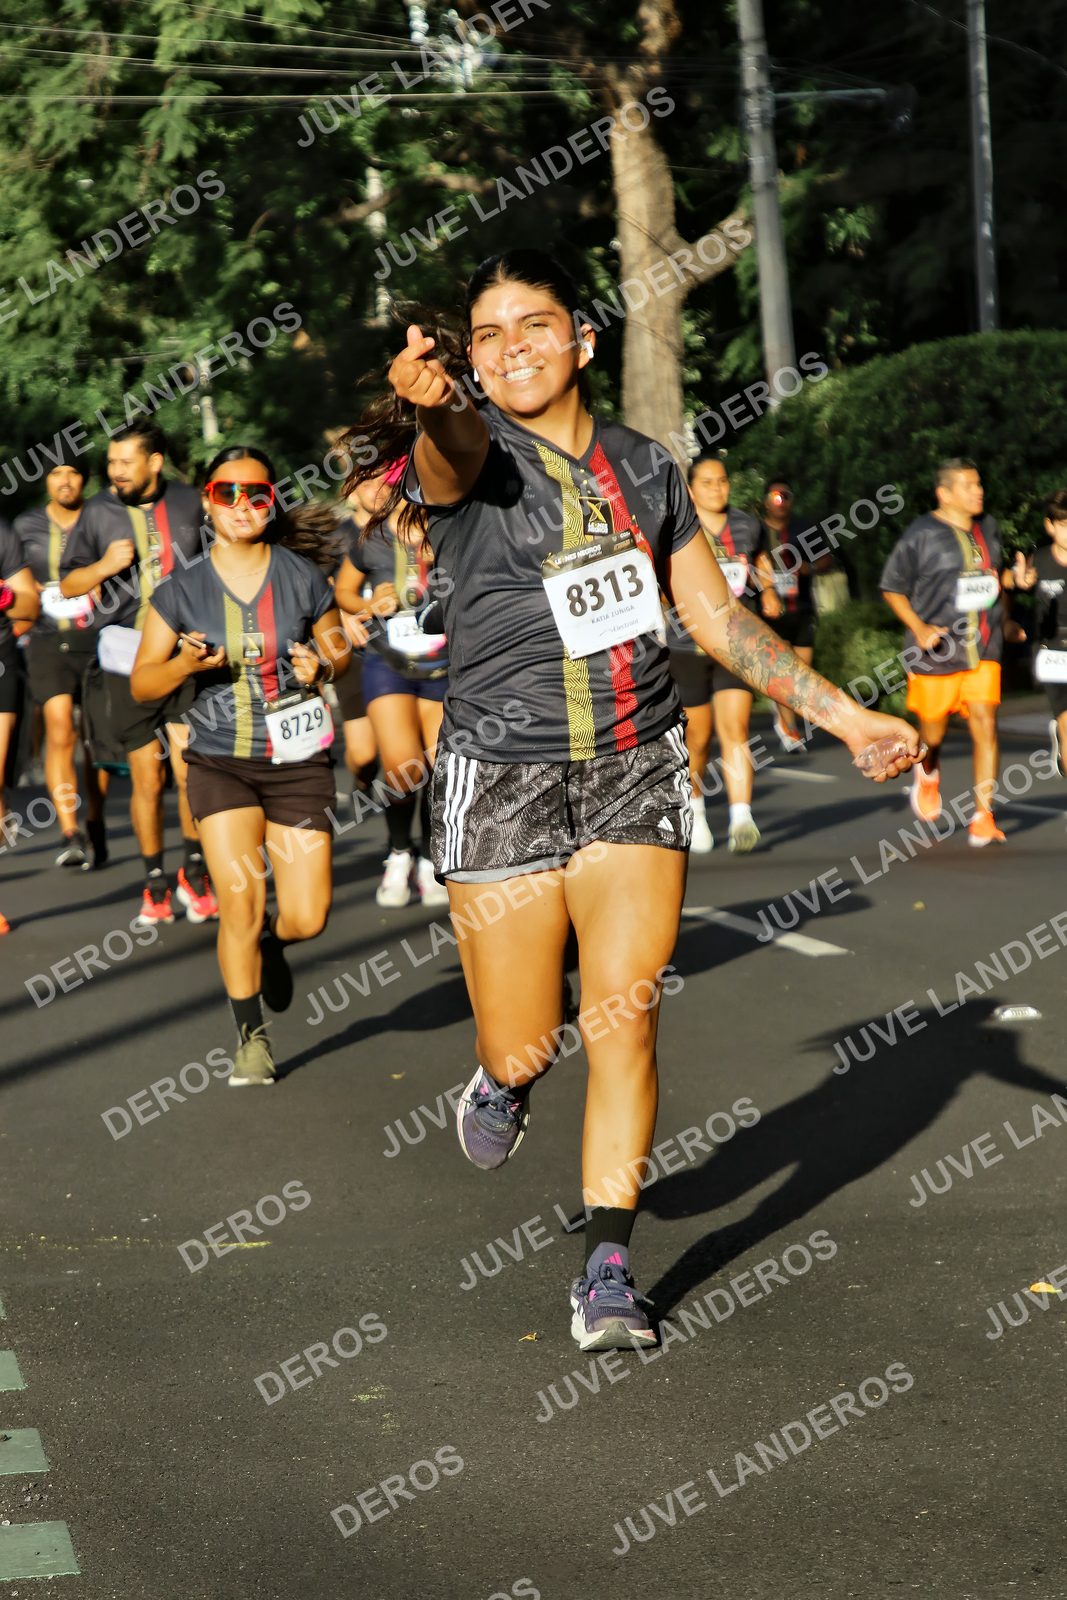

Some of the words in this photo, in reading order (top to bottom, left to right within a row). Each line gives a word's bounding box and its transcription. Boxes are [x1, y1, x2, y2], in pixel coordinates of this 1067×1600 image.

[566, 563, 644, 617] 8313
[591, 611, 610, 625] KATIA
[280, 707, 324, 740] 8729
